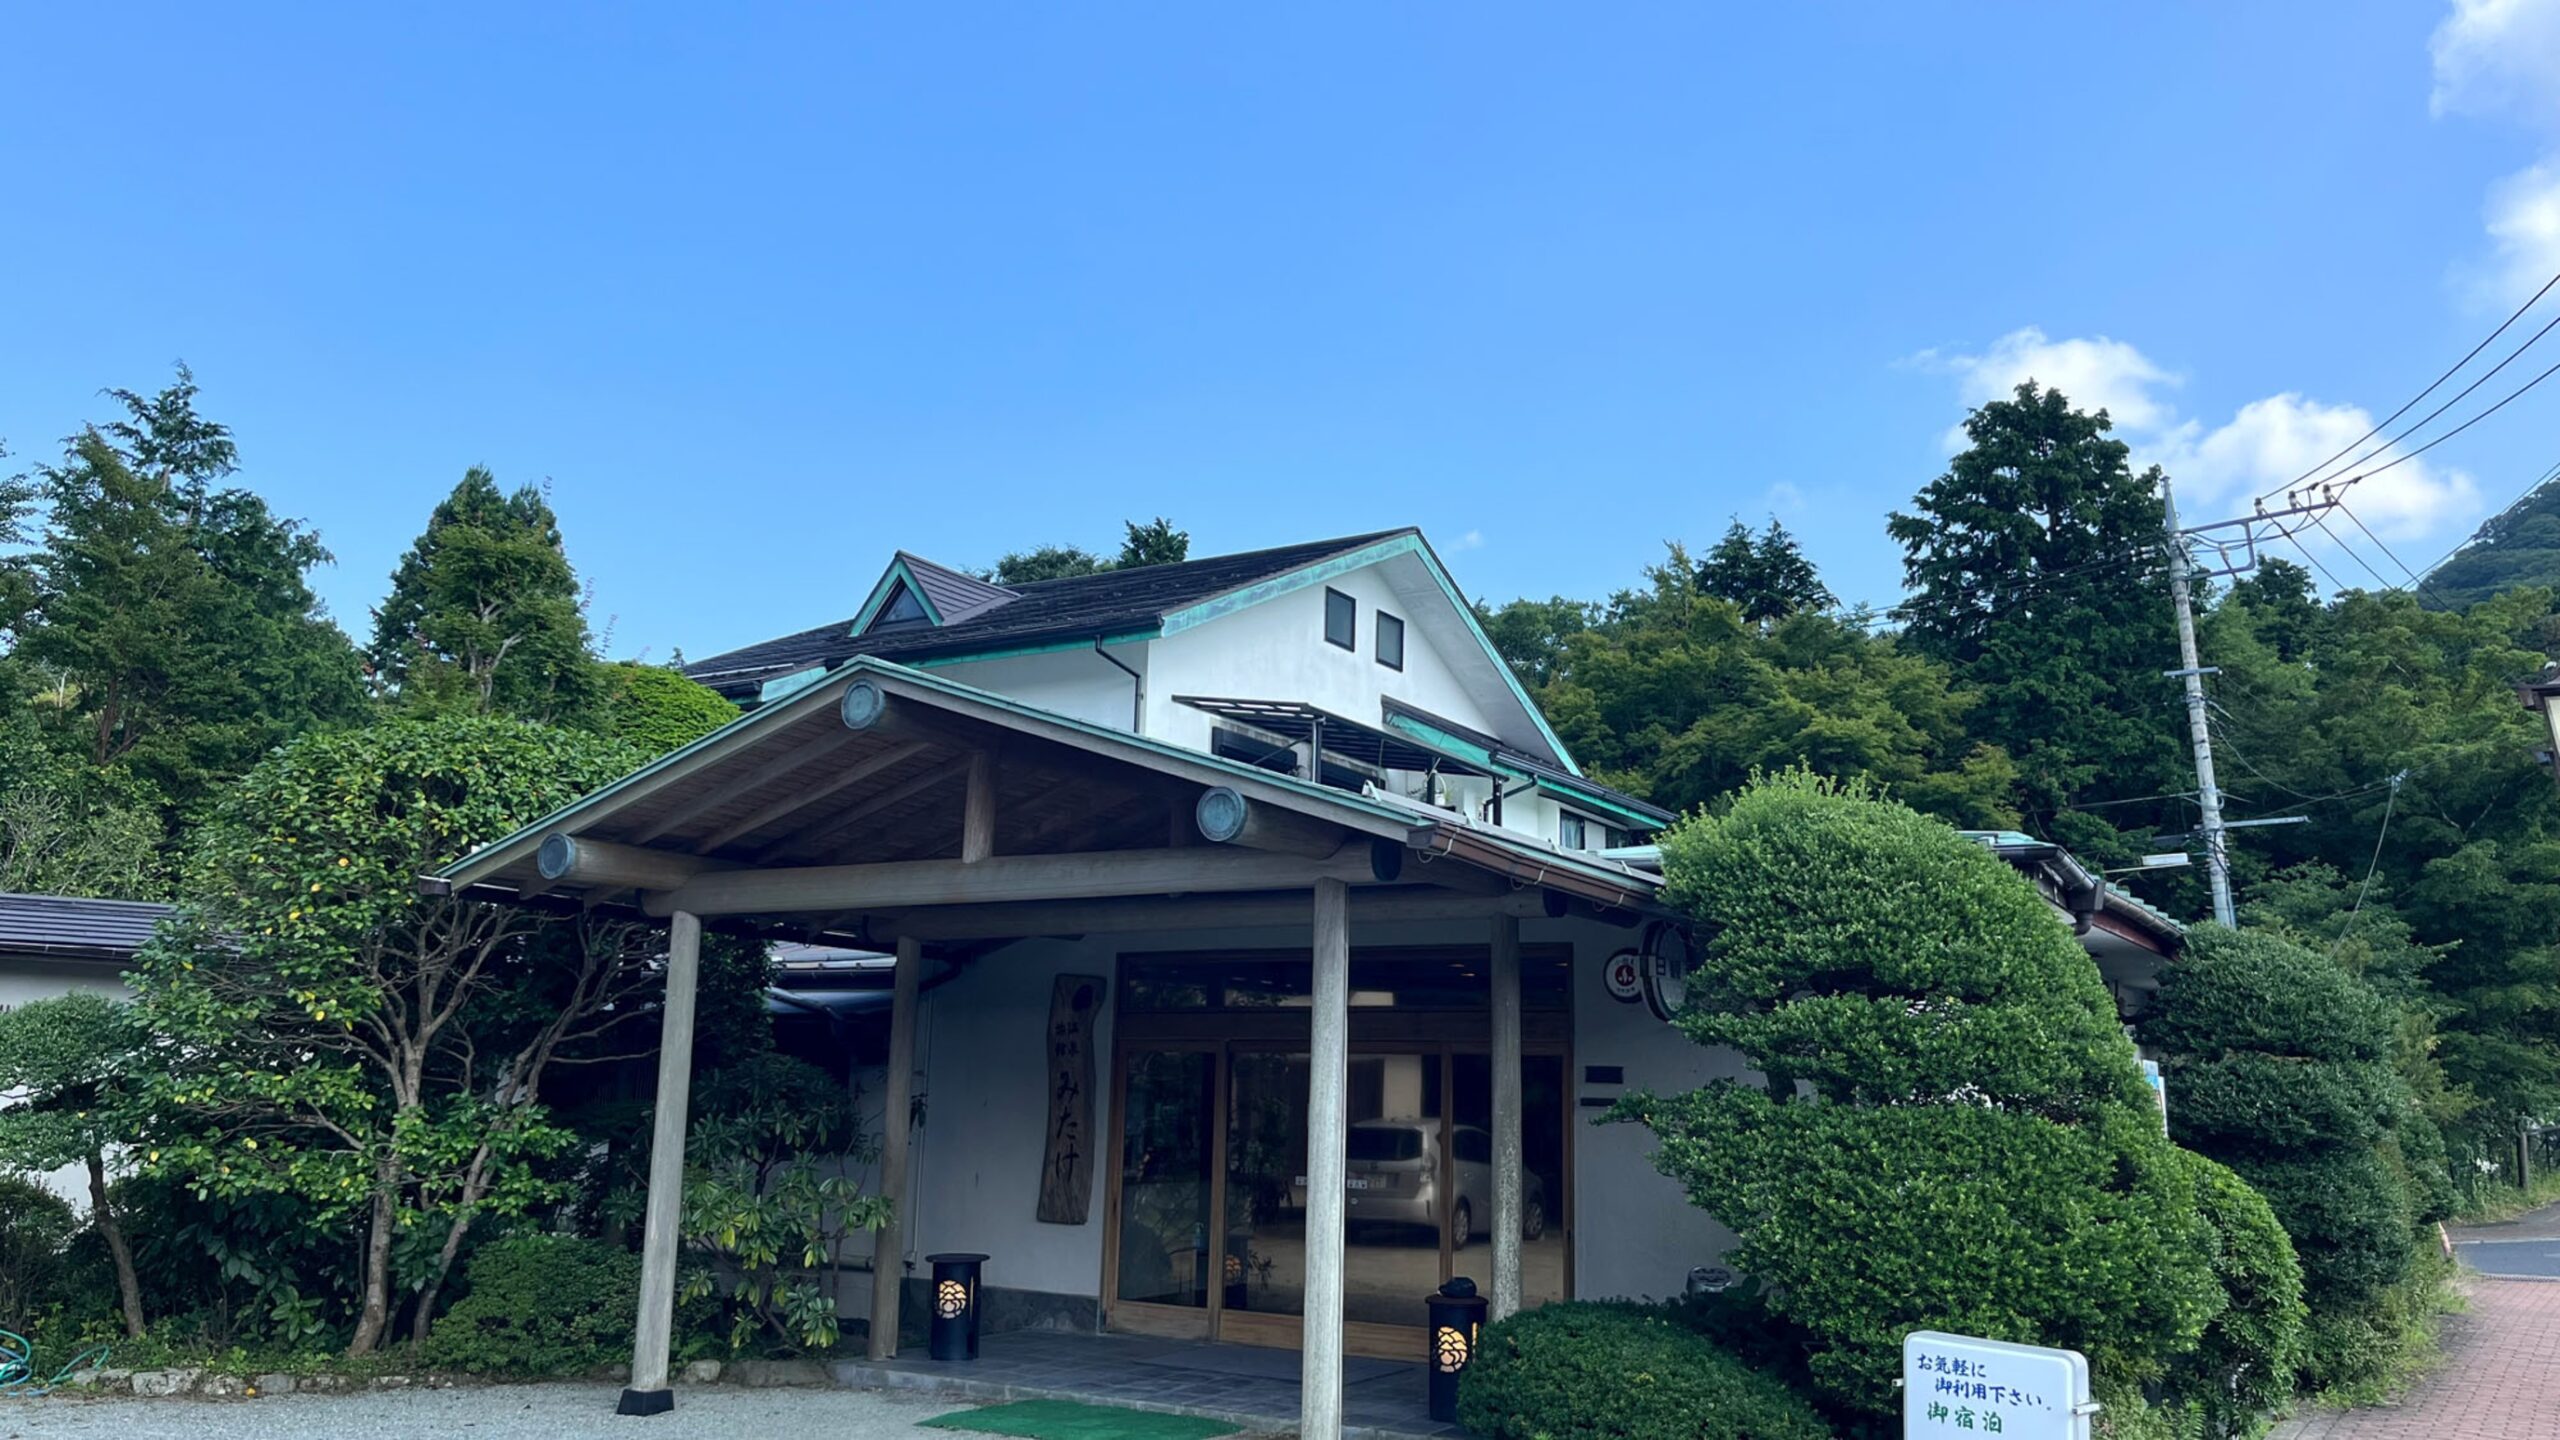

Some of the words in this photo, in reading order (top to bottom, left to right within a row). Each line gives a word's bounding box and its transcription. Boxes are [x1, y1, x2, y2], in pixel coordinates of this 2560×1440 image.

[1056, 1072, 1079, 1182] みたけ
[1917, 1353, 1987, 1378] お気軽に
[1935, 1377, 2052, 1411] 御利用下さい。
[1927, 1400, 2003, 1434] 御宿泊
